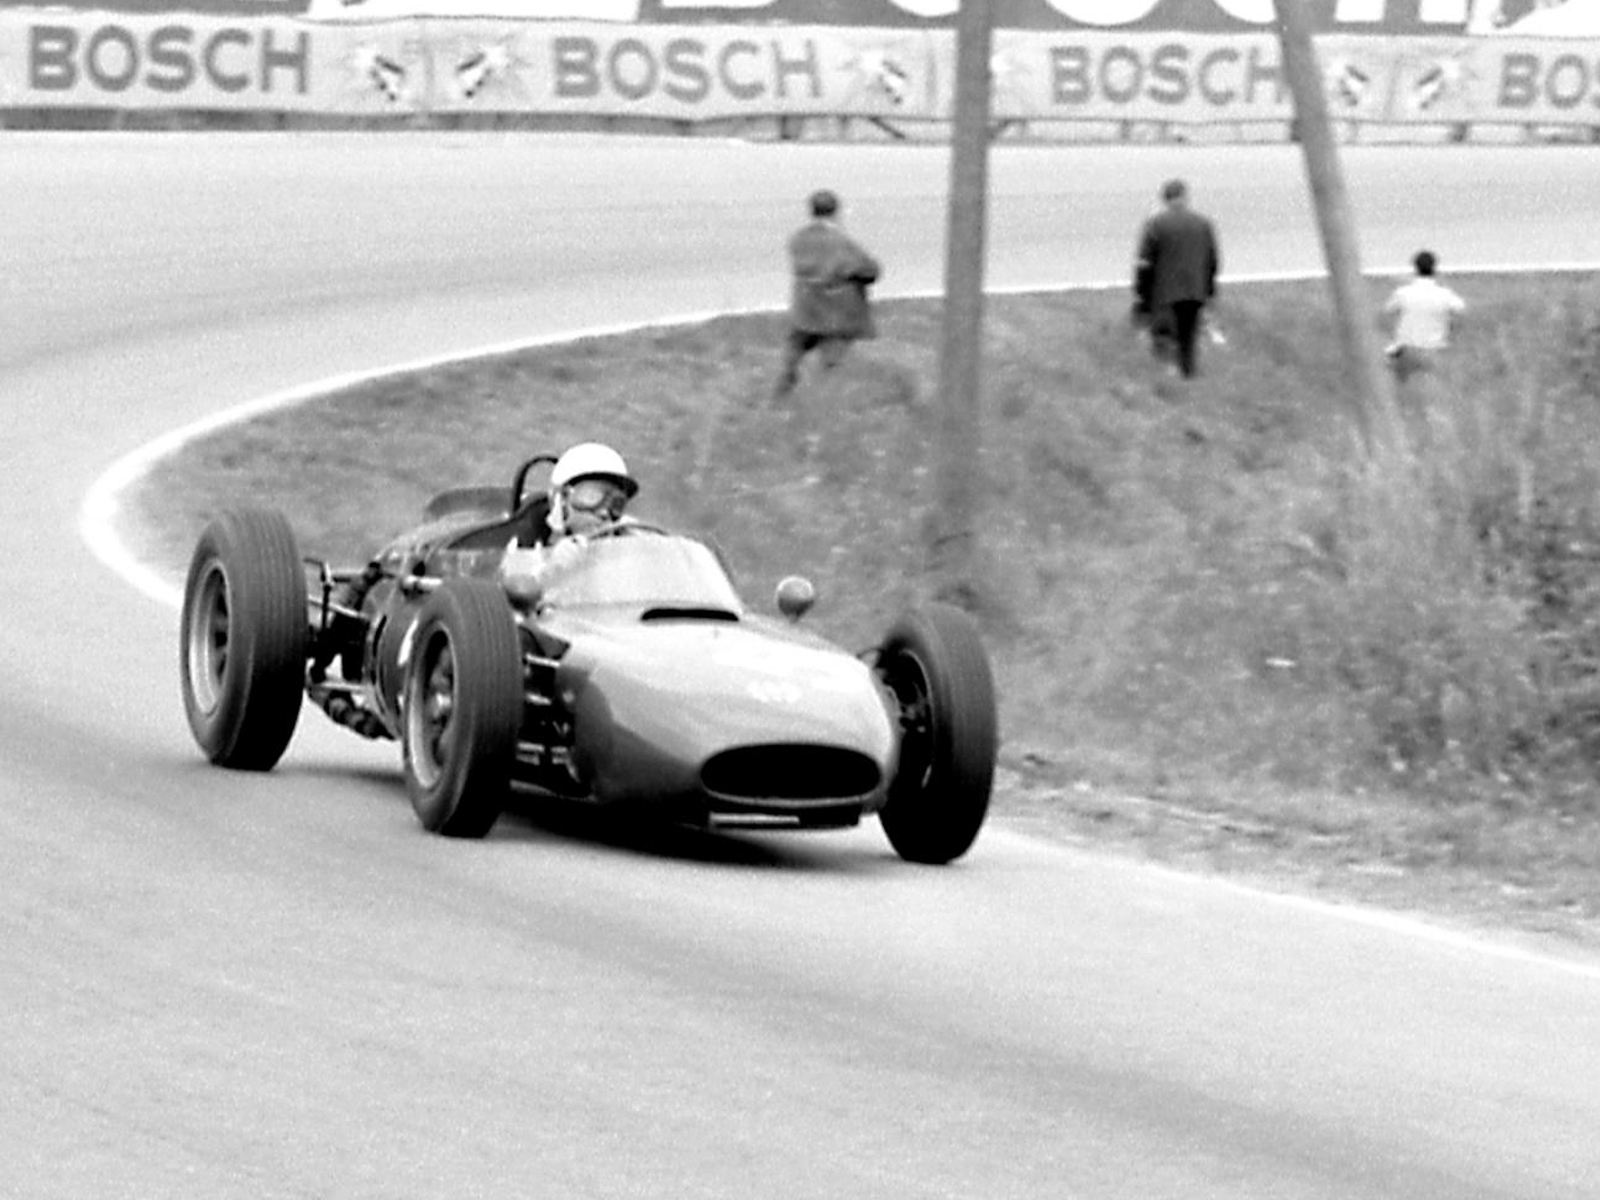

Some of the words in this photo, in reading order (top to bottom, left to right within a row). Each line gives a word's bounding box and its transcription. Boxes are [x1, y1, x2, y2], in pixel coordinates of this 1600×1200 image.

[29, 25, 310, 93] BOSCH
[554, 36, 824, 102] BOSCH
[1050, 45, 1288, 106] BOSCH
[1498, 53, 1600, 110] BO
